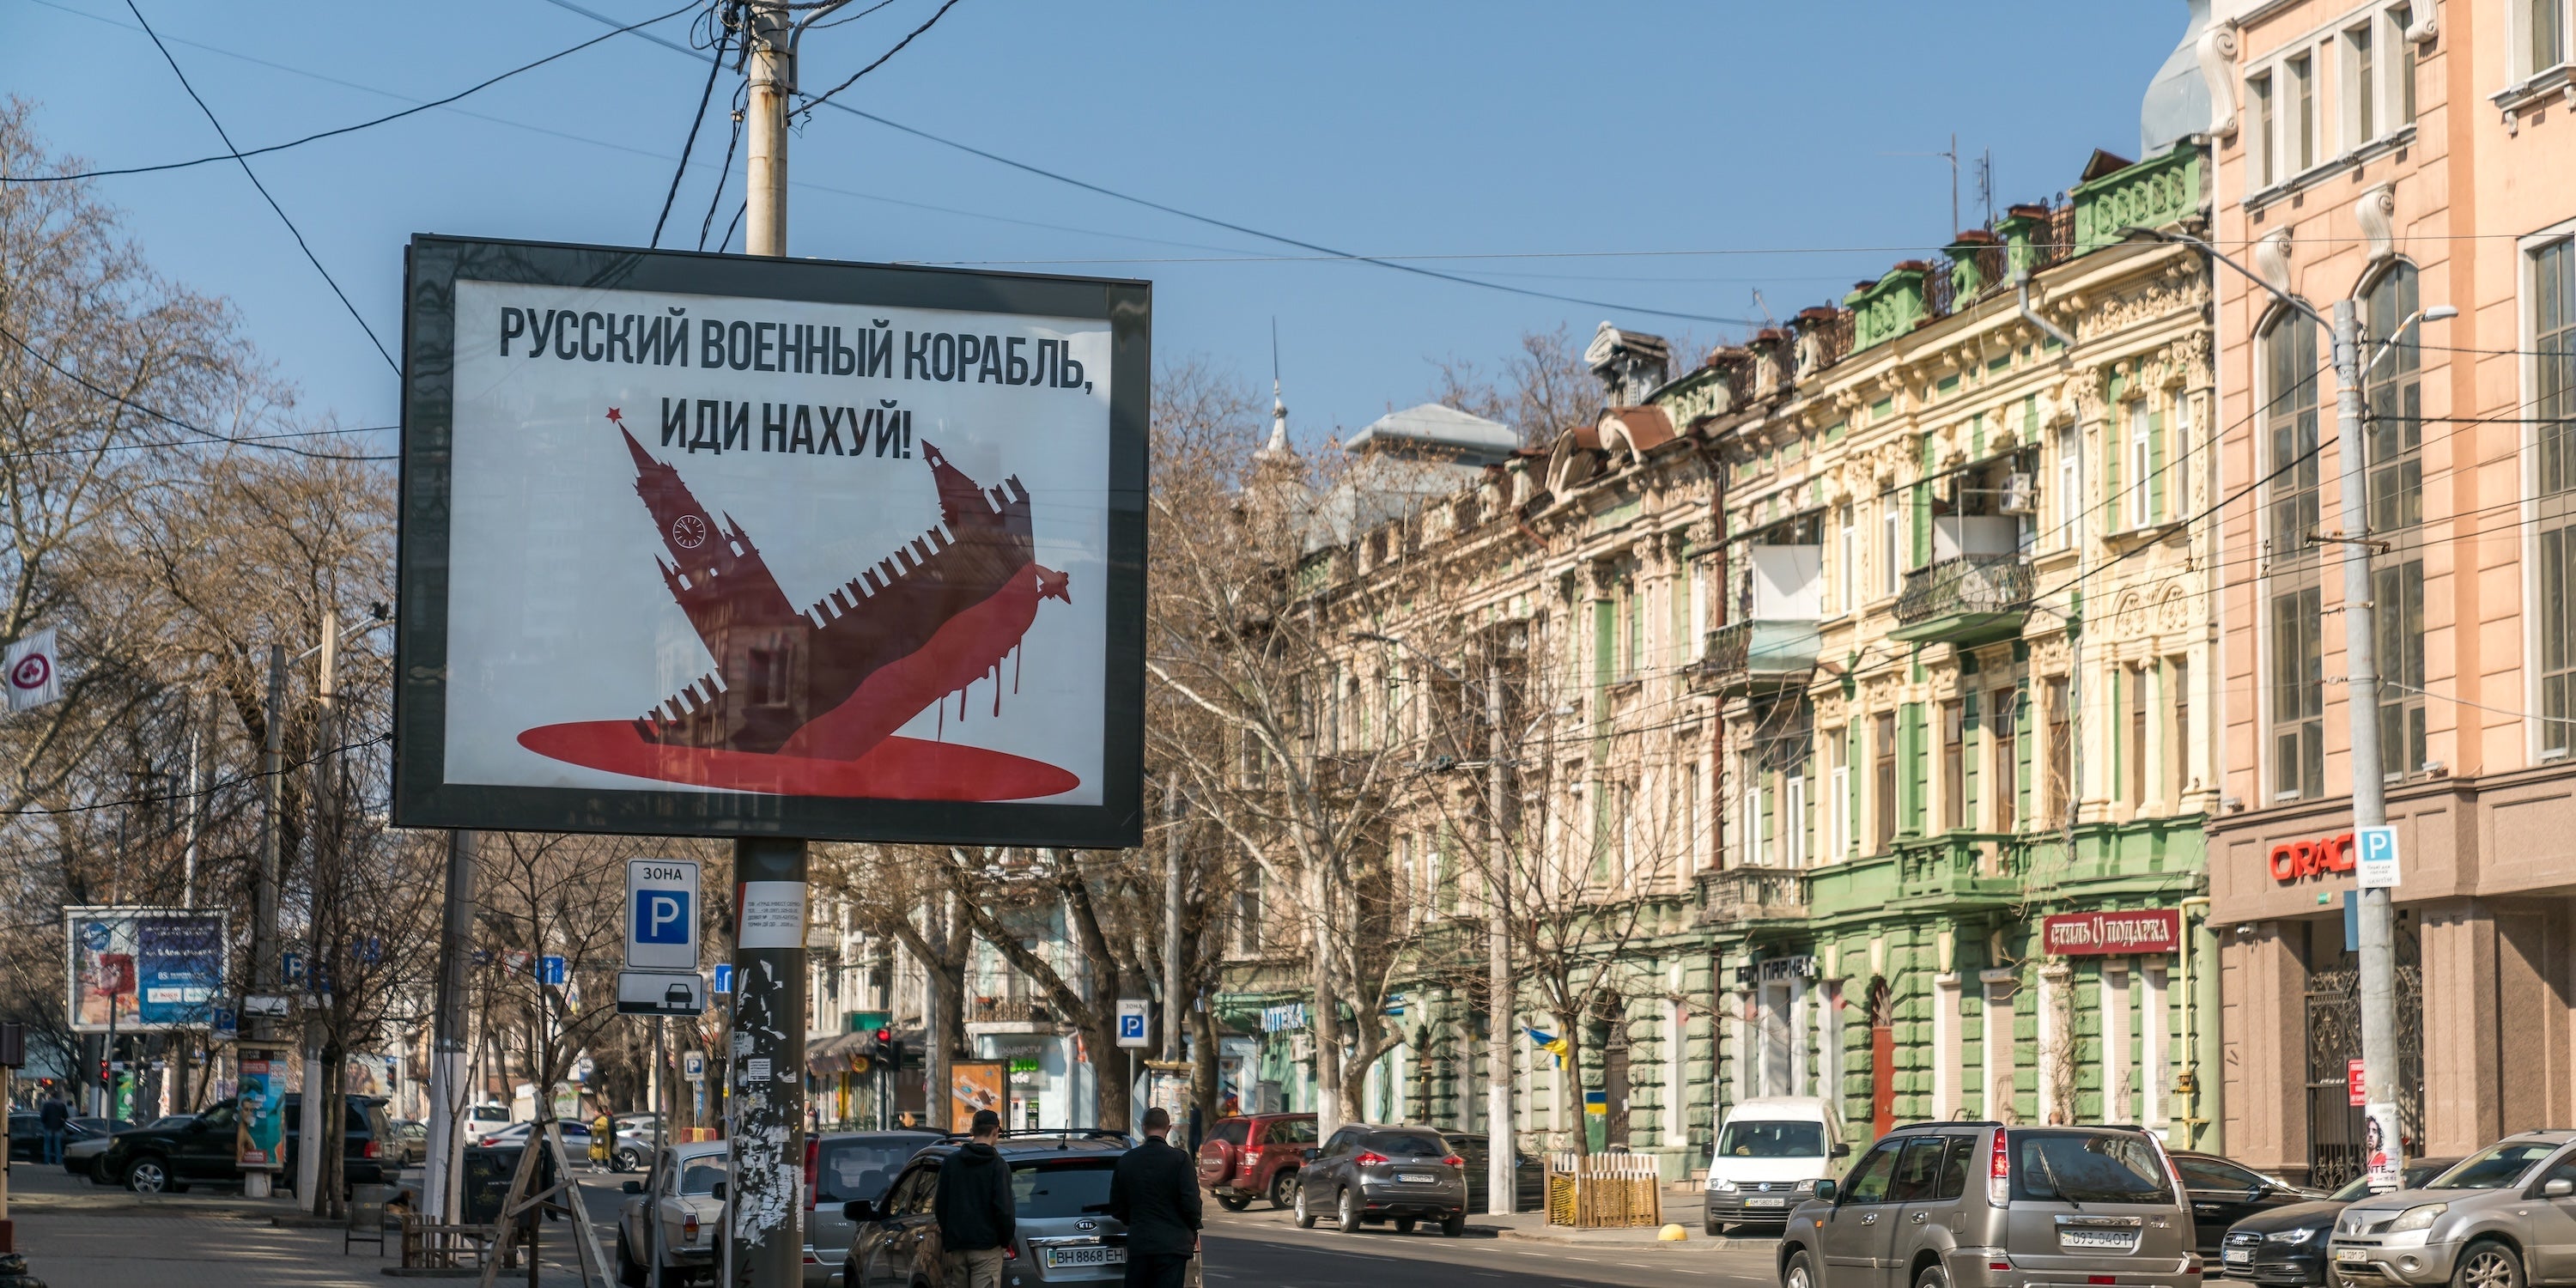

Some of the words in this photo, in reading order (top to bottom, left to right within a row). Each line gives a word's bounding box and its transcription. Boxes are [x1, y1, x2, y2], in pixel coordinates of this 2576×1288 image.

[500, 307, 689, 368] РУССКИЙ
[701, 319, 891, 380] ВОЕННЫЙ
[904, 331, 1093, 395] КОРАБЛЬ,
[660, 397, 750, 455] ИДИ
[762, 398, 912, 459] НАХУЙ!
[2269, 832, 2356, 880] ORAC
[2368, 832, 2387, 860] P
[642, 866, 683, 881] ЗОНА
[651, 896, 680, 938] P
[2050, 921, 2091, 945] СТИЛЬ
[2105, 918, 2171, 948] ПОДАРКА
[1127, 1018, 1140, 1036] P
[1010, 1071, 1030, 1084] ебе
[1056, 1251, 1074, 1264] BH
[1076, 1250, 1103, 1263] 8868
[1106, 1249, 1123, 1261] EH
